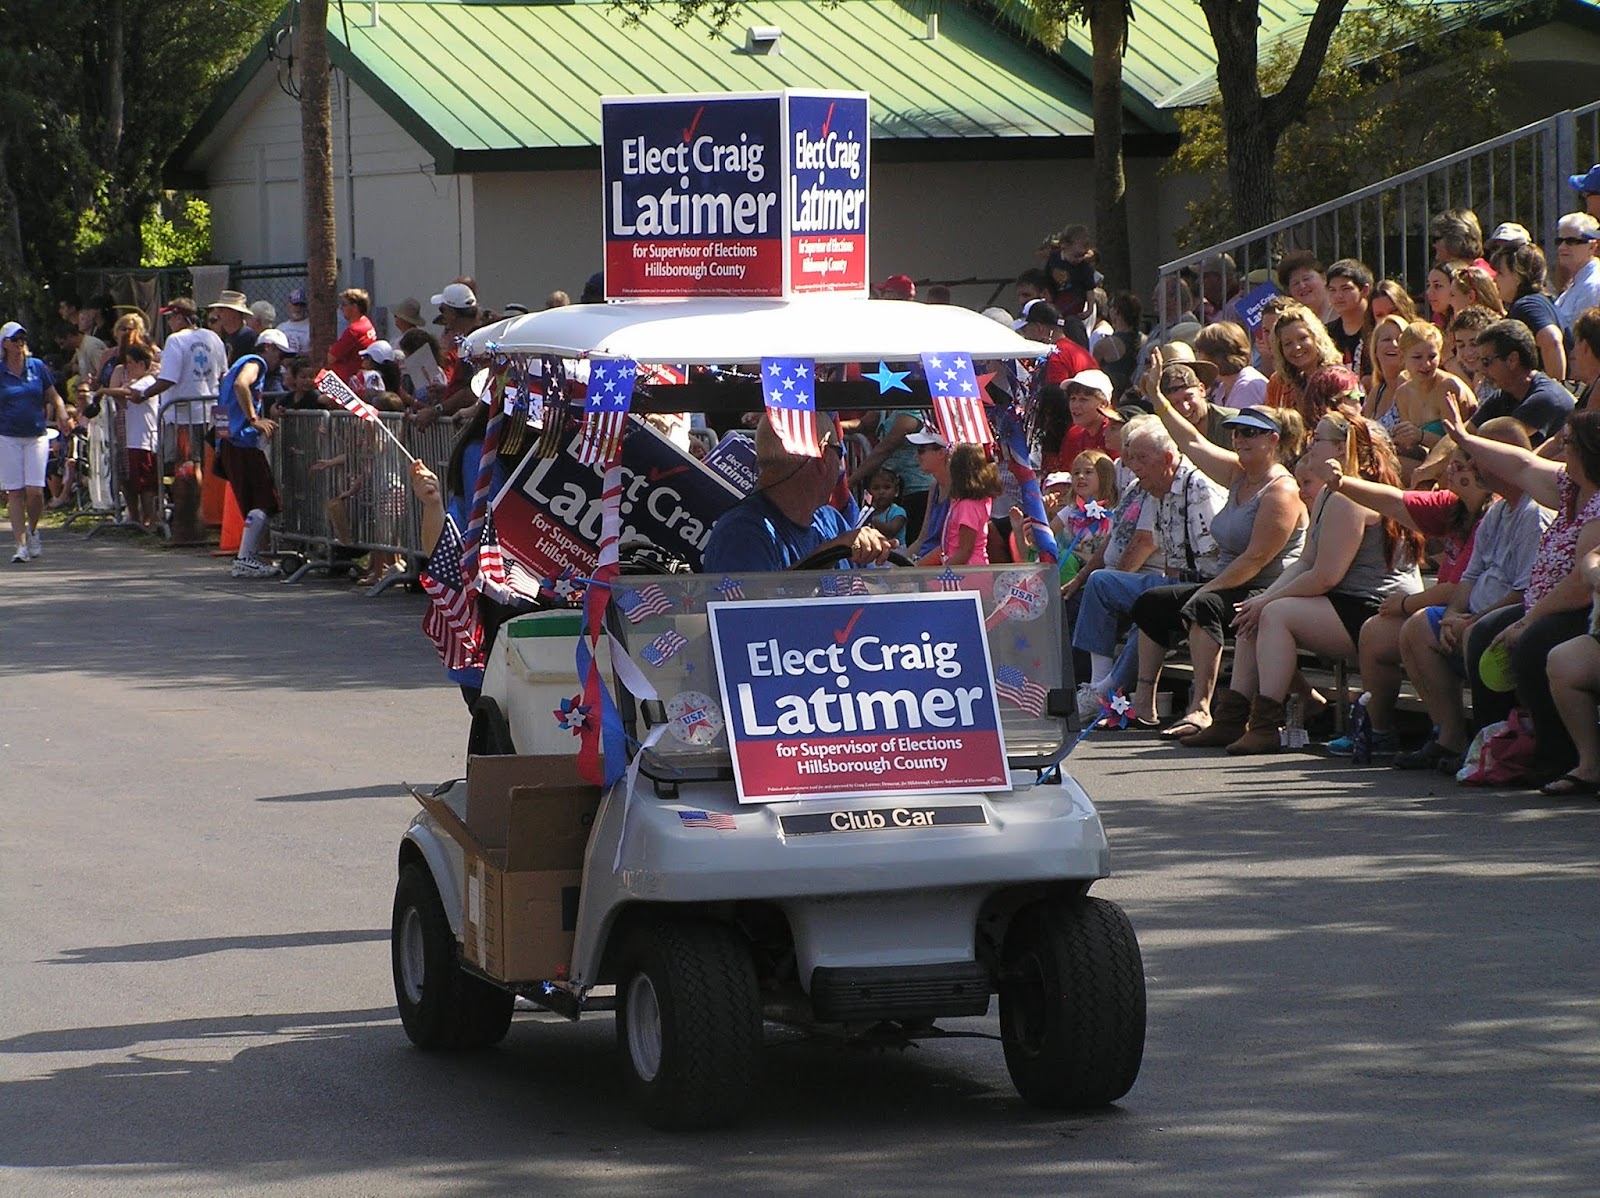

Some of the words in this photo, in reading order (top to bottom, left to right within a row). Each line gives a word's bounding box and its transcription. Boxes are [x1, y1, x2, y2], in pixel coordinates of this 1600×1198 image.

[622, 135, 688, 175] Elect
[692, 132, 765, 182] Craig
[795, 129, 825, 170] Elect
[825, 130, 860, 180] Craig
[612, 175, 777, 236] Latimer
[790, 171, 865, 232] Latimer
[632, 243, 648, 258] for
[648, 243, 701, 261] Supervisor
[702, 242, 714, 258] of
[714, 242, 757, 258] Elections
[645, 262, 707, 279] Hillsborough
[708, 262, 746, 280] County
[712, 455, 754, 491] Latimer
[531, 513, 551, 532] for
[549, 526, 600, 568] Supervis
[647, 486, 718, 562] Crai
[1011, 588, 1033, 602] USA
[747, 639, 847, 677] Elect
[850, 632, 962, 679] Craig
[682, 710, 706, 725] USA
[737, 675, 983, 736] Latimer
[776, 743, 798, 758] for
[800, 740, 878, 759] Supervisor
[881, 737, 896, 752] of
[898, 736, 963, 752] Elections
[797, 758, 891, 775] Hillsborough
[893, 756, 948, 772] County
[830, 810, 886, 831] Club
[891, 808, 935, 827] Car
